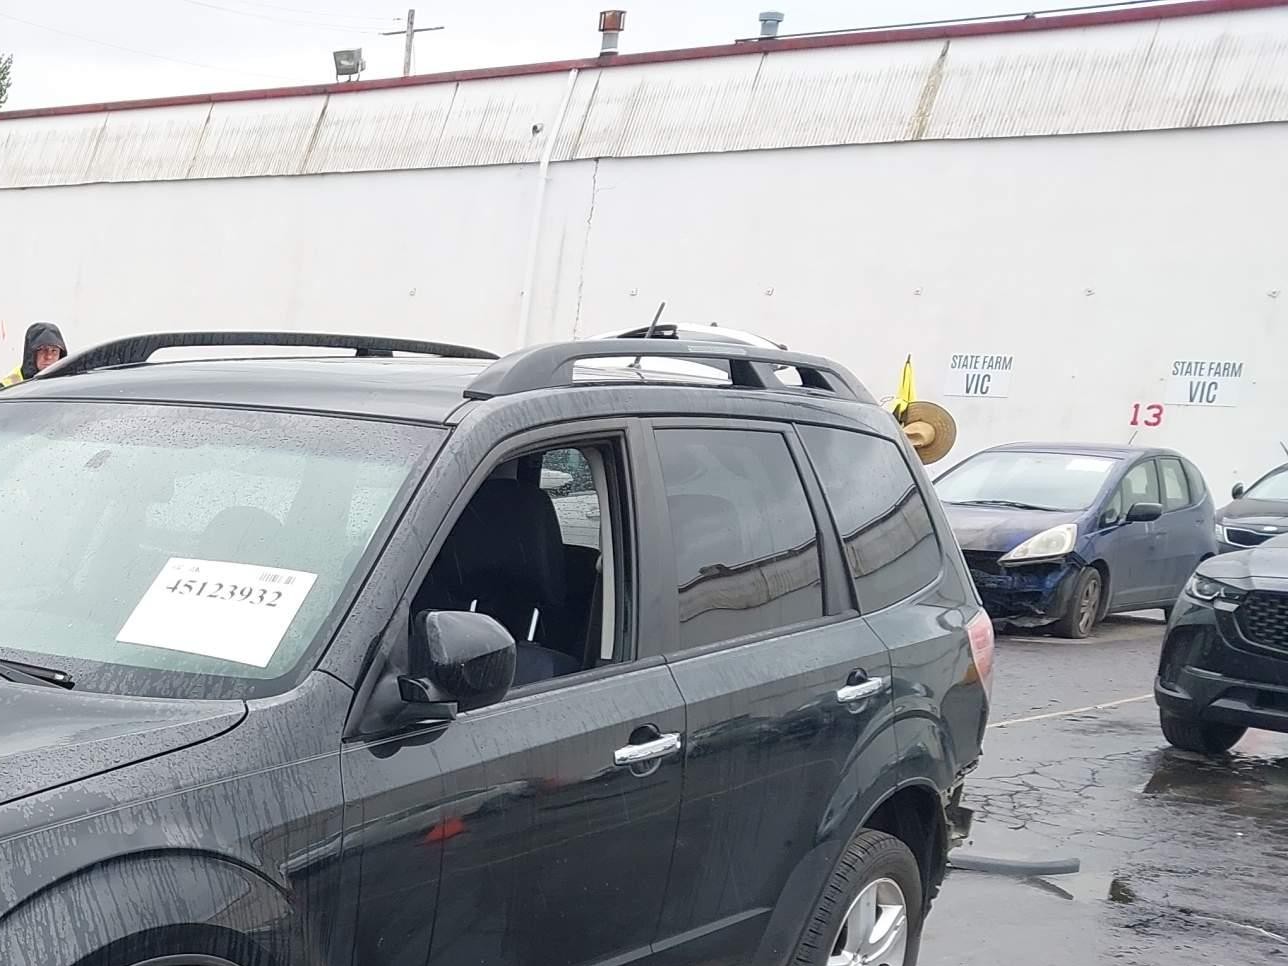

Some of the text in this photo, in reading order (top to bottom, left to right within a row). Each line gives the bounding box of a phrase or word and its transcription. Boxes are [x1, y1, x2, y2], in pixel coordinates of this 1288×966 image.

[951, 355, 1013, 370] STATE FARM
[1172, 361, 1244, 378] STATE FARM
[965, 373, 991, 395] VIC
[1189, 381, 1218, 403] VIC
[1130, 403, 1163, 427] 13
[166, 579, 282, 607] 45123932
